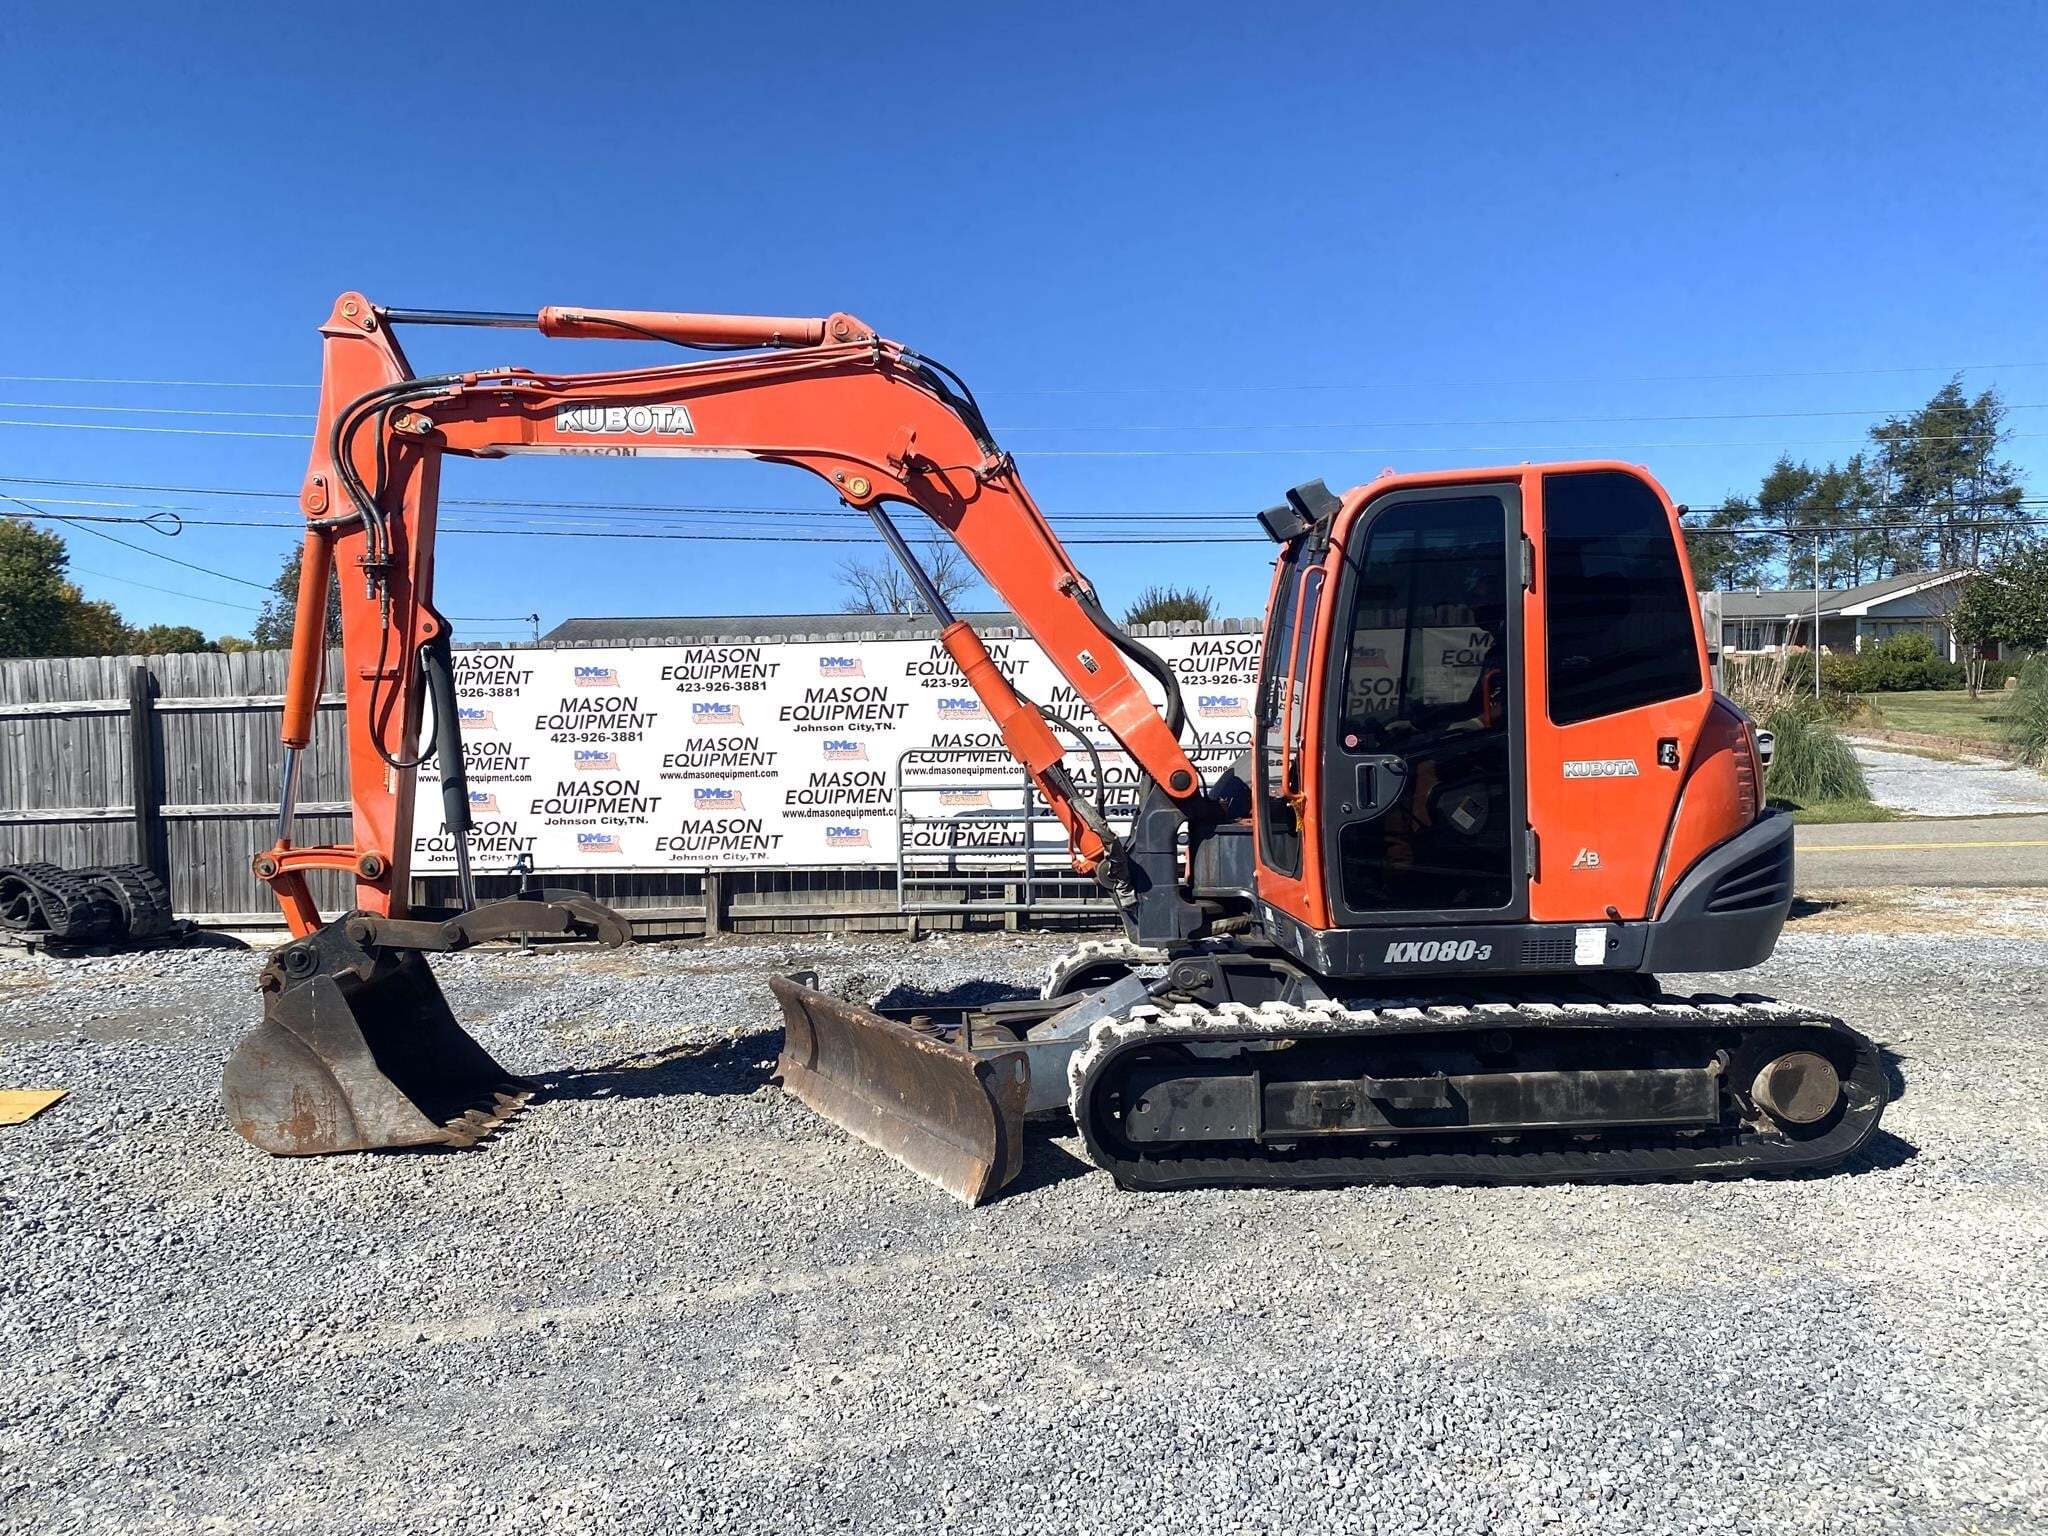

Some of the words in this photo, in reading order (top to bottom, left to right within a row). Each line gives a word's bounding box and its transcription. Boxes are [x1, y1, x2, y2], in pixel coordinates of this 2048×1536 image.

[556, 405, 694, 434] KUBOTA
[685, 648, 761, 664] MASON
[661, 663, 780, 680] EQUIPMENT
[1168, 656, 1260, 673] EQUIPME
[454, 671, 534, 686] IPMENT
[676, 681, 767, 692] 423-926-3881
[1182, 674, 1258, 685] 423-926-38
[456, 688, 520, 698] -926-3881
[804, 686, 888, 703] MASON
[560, 697, 638, 713] MASON
[779, 703, 910, 721] EQUIPMENT
[535, 713, 658, 730] EQUIPMENT
[793, 724, 844, 732] Johnson
[550, 732, 643, 743] 423-926-3881
[685, 737, 759, 752] MASON
[1192, 731, 1252, 745] MASO
[462, 742, 512, 756] ASON
[662, 752, 778, 768] EQUIPMENT
[908, 752, 1012, 763] EQUIPMEN
[660, 769, 779, 780] www.dmasonequipment.com
[1565, 761, 1637, 777] KUBOTA
[809, 771, 886, 788] MASON
[557, 780, 640, 797] MASON
[785, 788, 897, 805] EQUIPMEN
[530, 797, 662, 814] EQUIPMENT
[544, 818, 597, 826] Johnson
[681, 819, 762, 835] MASON
[415, 837, 537, 852] EQUPMENT
[655, 834, 784, 851] EQUIPMENT
[1384, 940, 1493, 963] KX080-3
